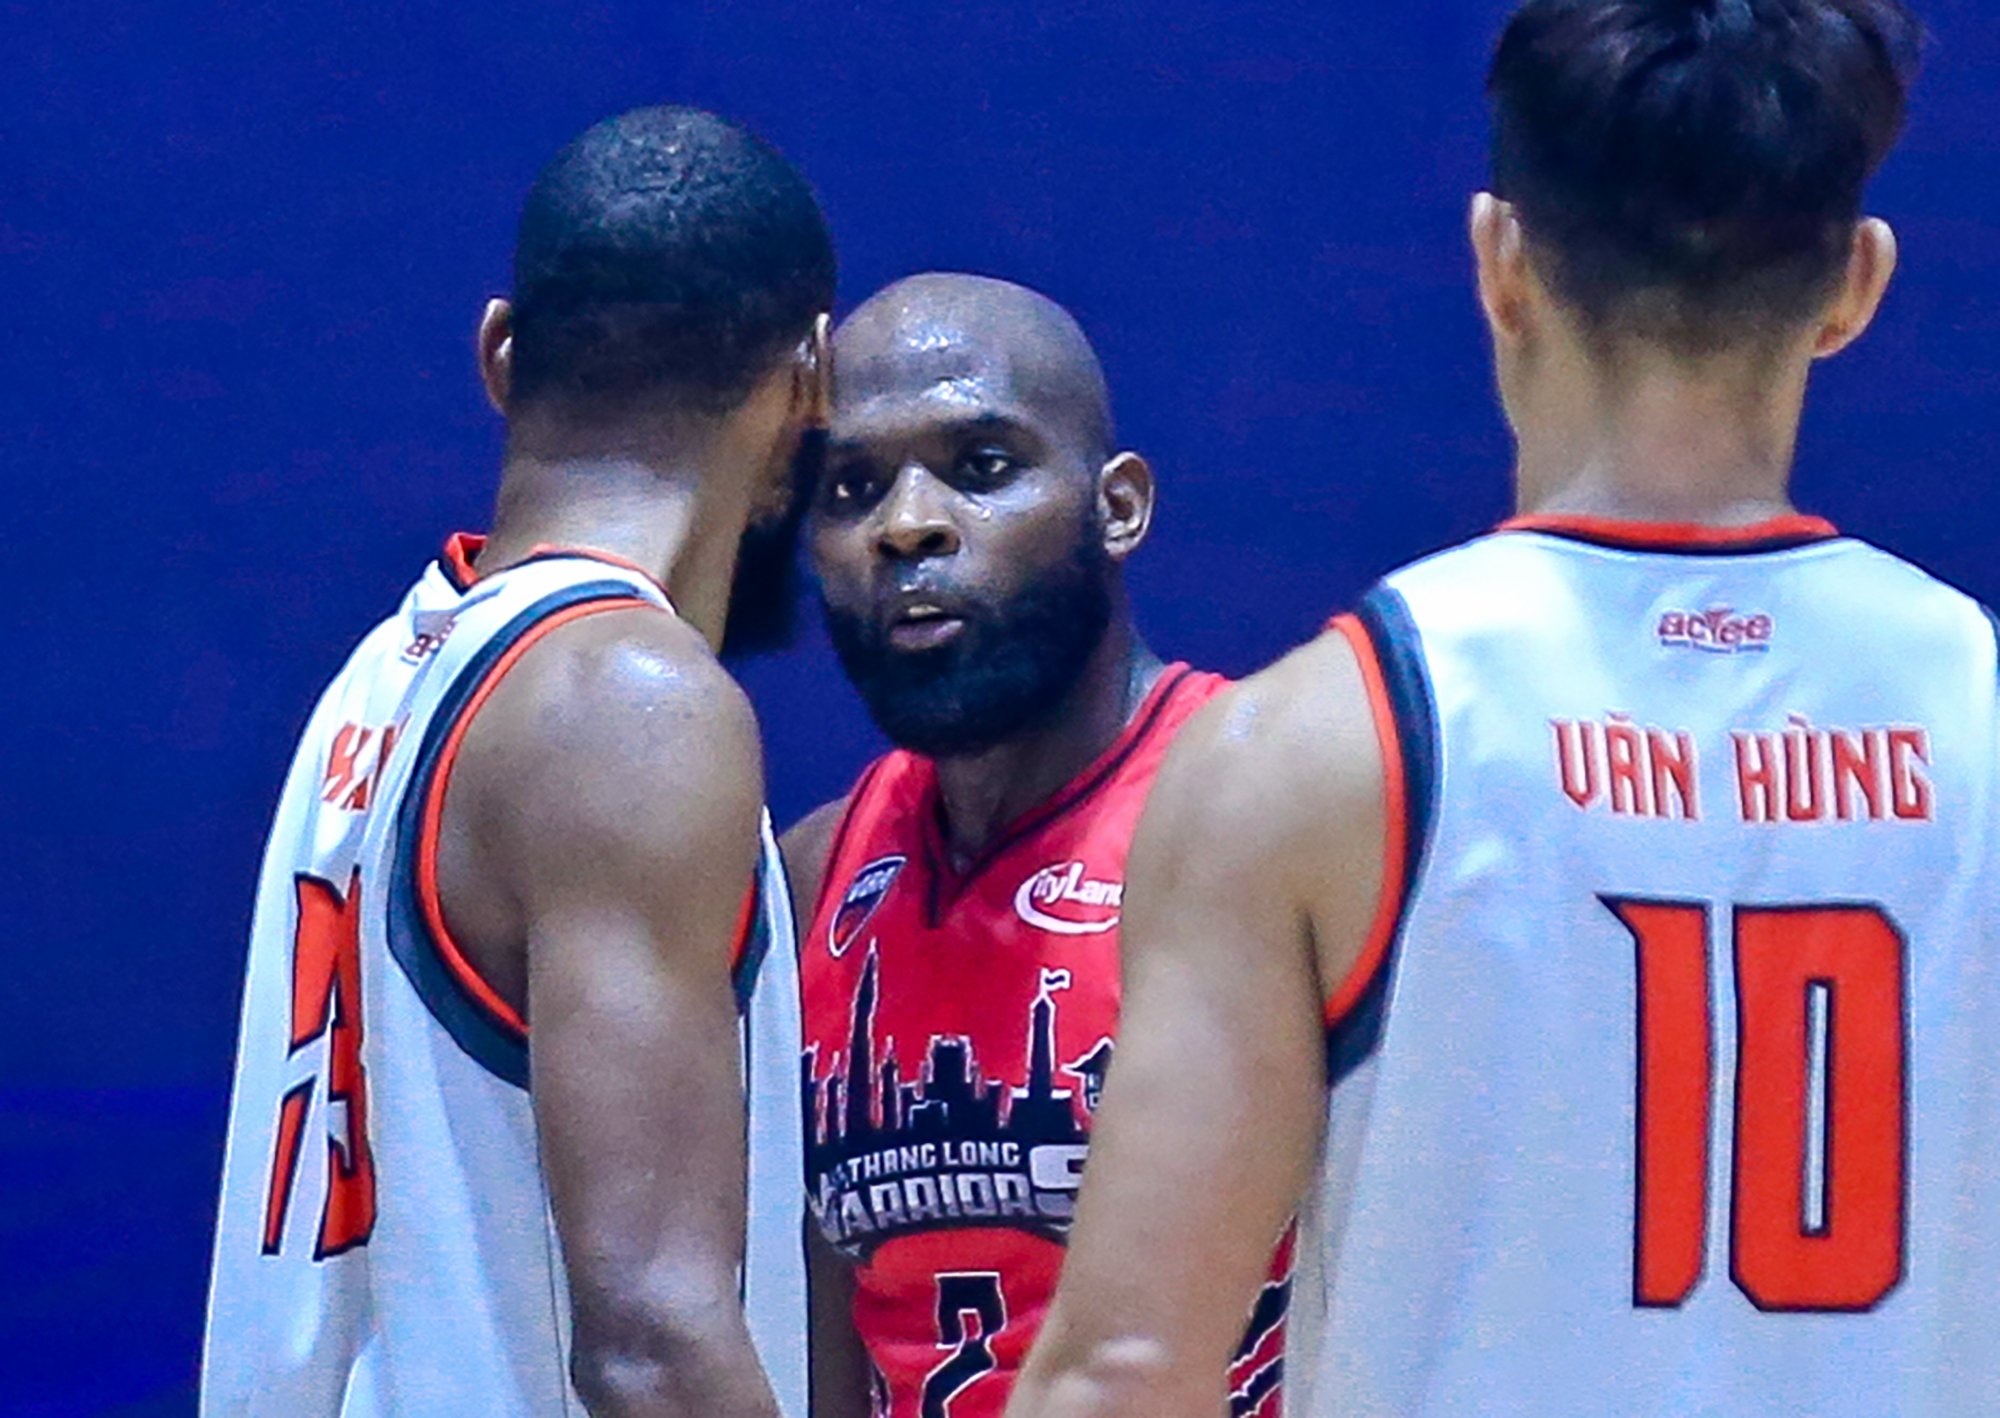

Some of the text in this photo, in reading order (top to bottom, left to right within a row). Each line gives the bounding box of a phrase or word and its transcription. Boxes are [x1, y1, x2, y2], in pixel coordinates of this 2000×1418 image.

[1730, 711, 1936, 823] HÙNG
[941, 1140, 1021, 1167] LONG
[1594, 893, 1911, 1313] 10
